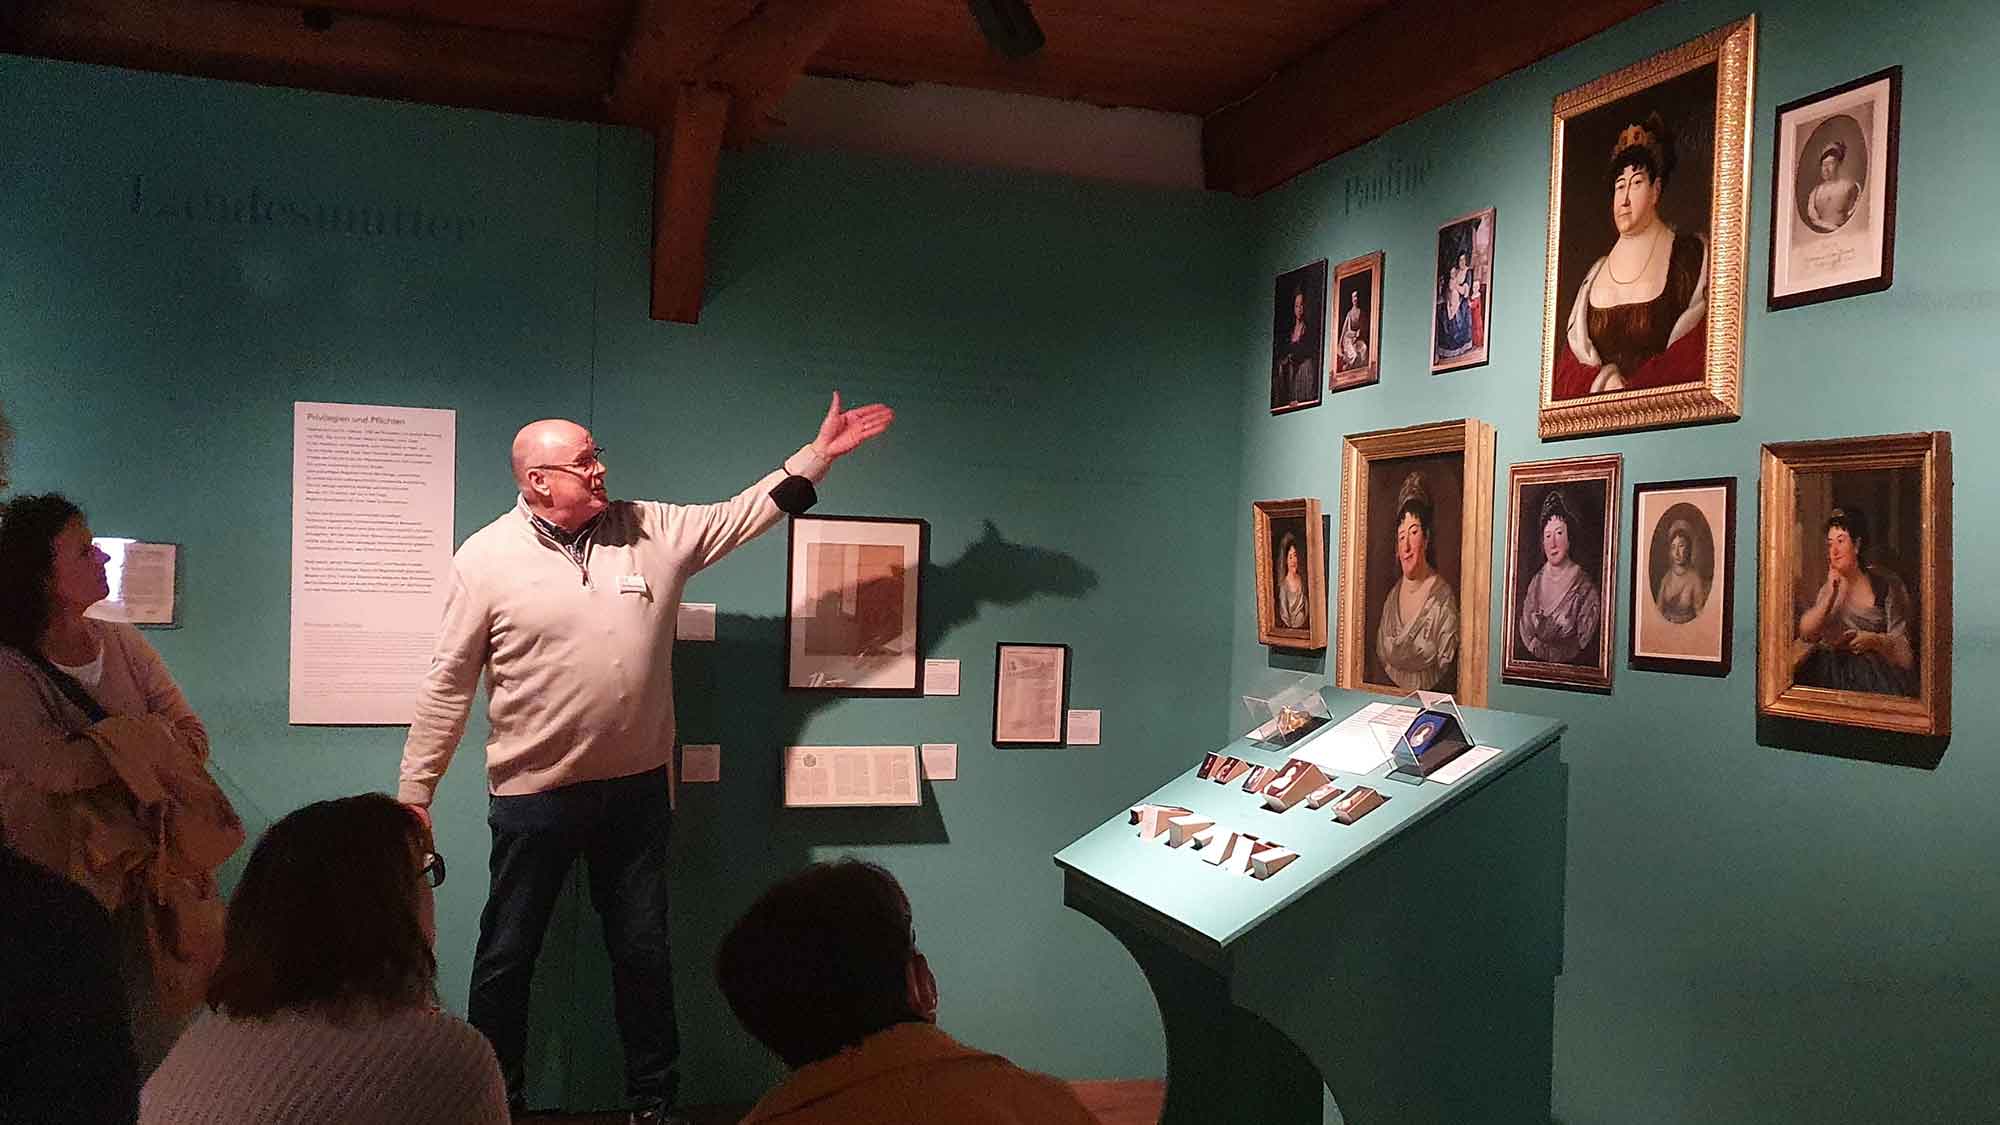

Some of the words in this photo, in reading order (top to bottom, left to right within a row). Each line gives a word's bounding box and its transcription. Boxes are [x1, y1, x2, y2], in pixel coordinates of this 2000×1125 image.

[129, 173, 479, 241] Landesmutter
[1345, 157, 1433, 216] Pauline
[307, 413, 350, 423] Privilegien
[353, 415, 368, 424] und
[371, 416, 405, 425] Pflichten
